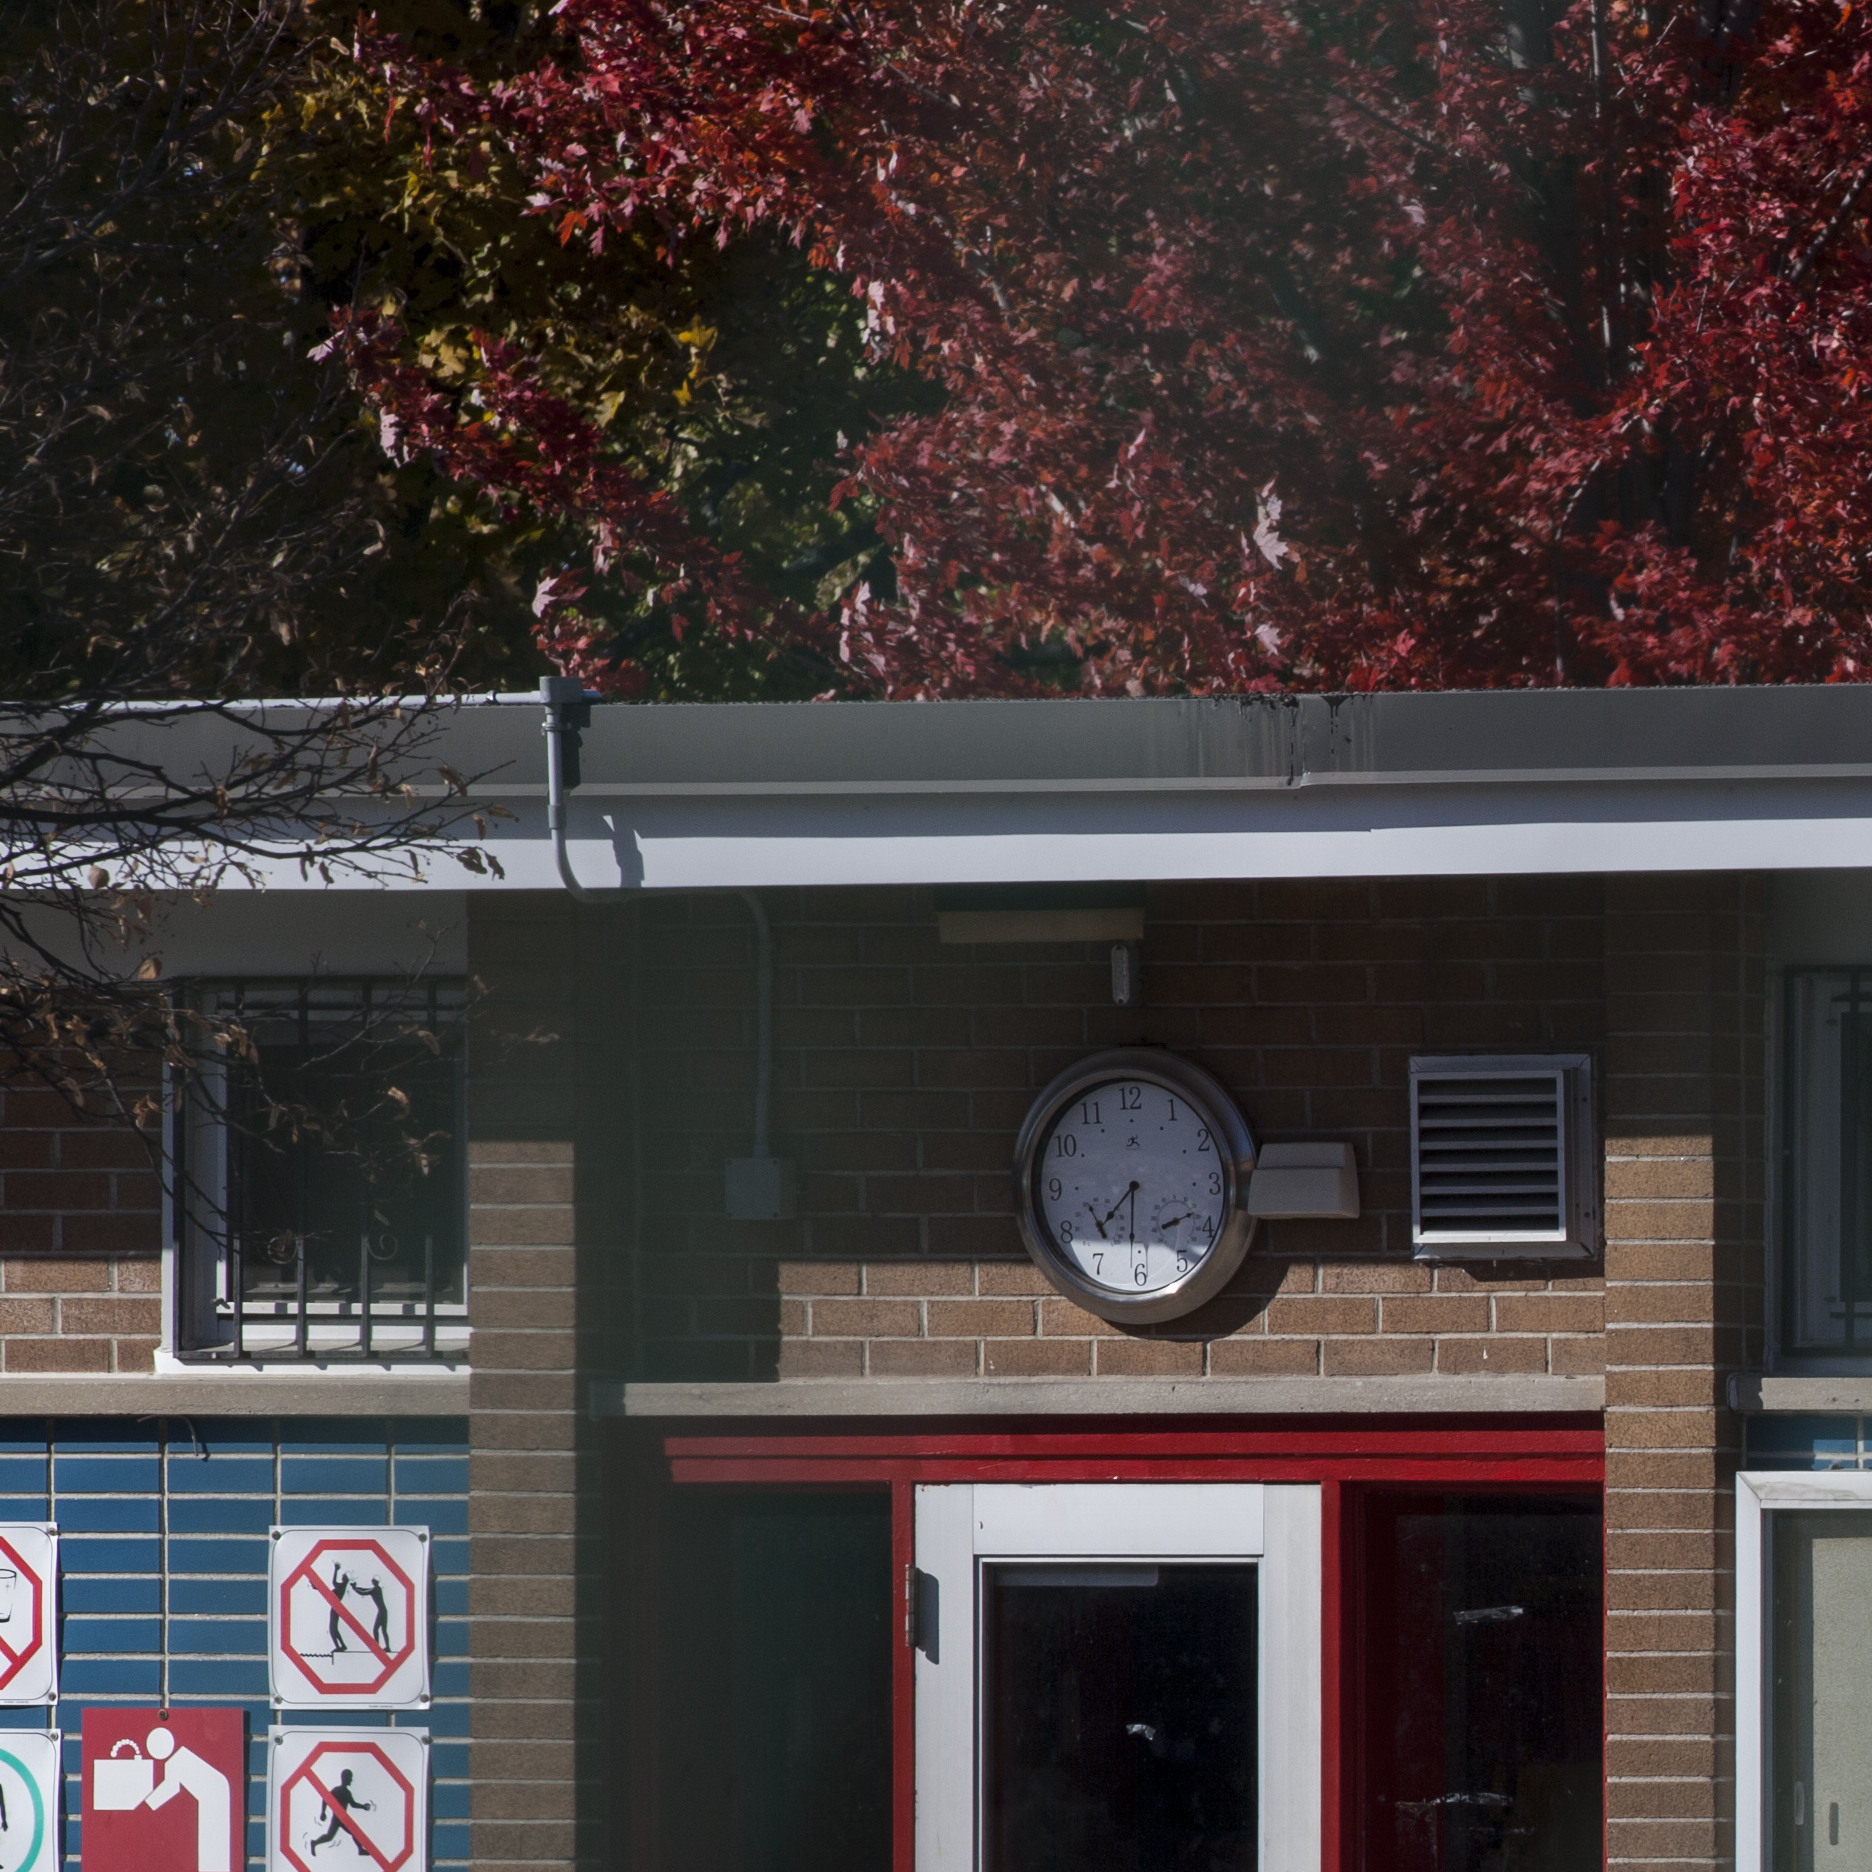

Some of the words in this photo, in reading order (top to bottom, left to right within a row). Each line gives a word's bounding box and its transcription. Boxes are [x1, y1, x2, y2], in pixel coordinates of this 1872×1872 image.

[1119, 1087, 1143, 1110] 12
[1167, 1098, 1178, 1121] 1
[1081, 1101, 1103, 1125] 11
[1055, 1133, 1077, 1157] 10
[1197, 1128, 1210, 1152] 2
[1049, 1178, 1062, 1201] 9
[1209, 1171, 1221, 1195] 3
[1060, 1220, 1073, 1244] 8
[1202, 1215, 1214, 1238] 4
[1093, 1253, 1104, 1275] 7
[1176, 1250, 1188, 1273] 5
[1135, 1263, 1147, 1286] 6
